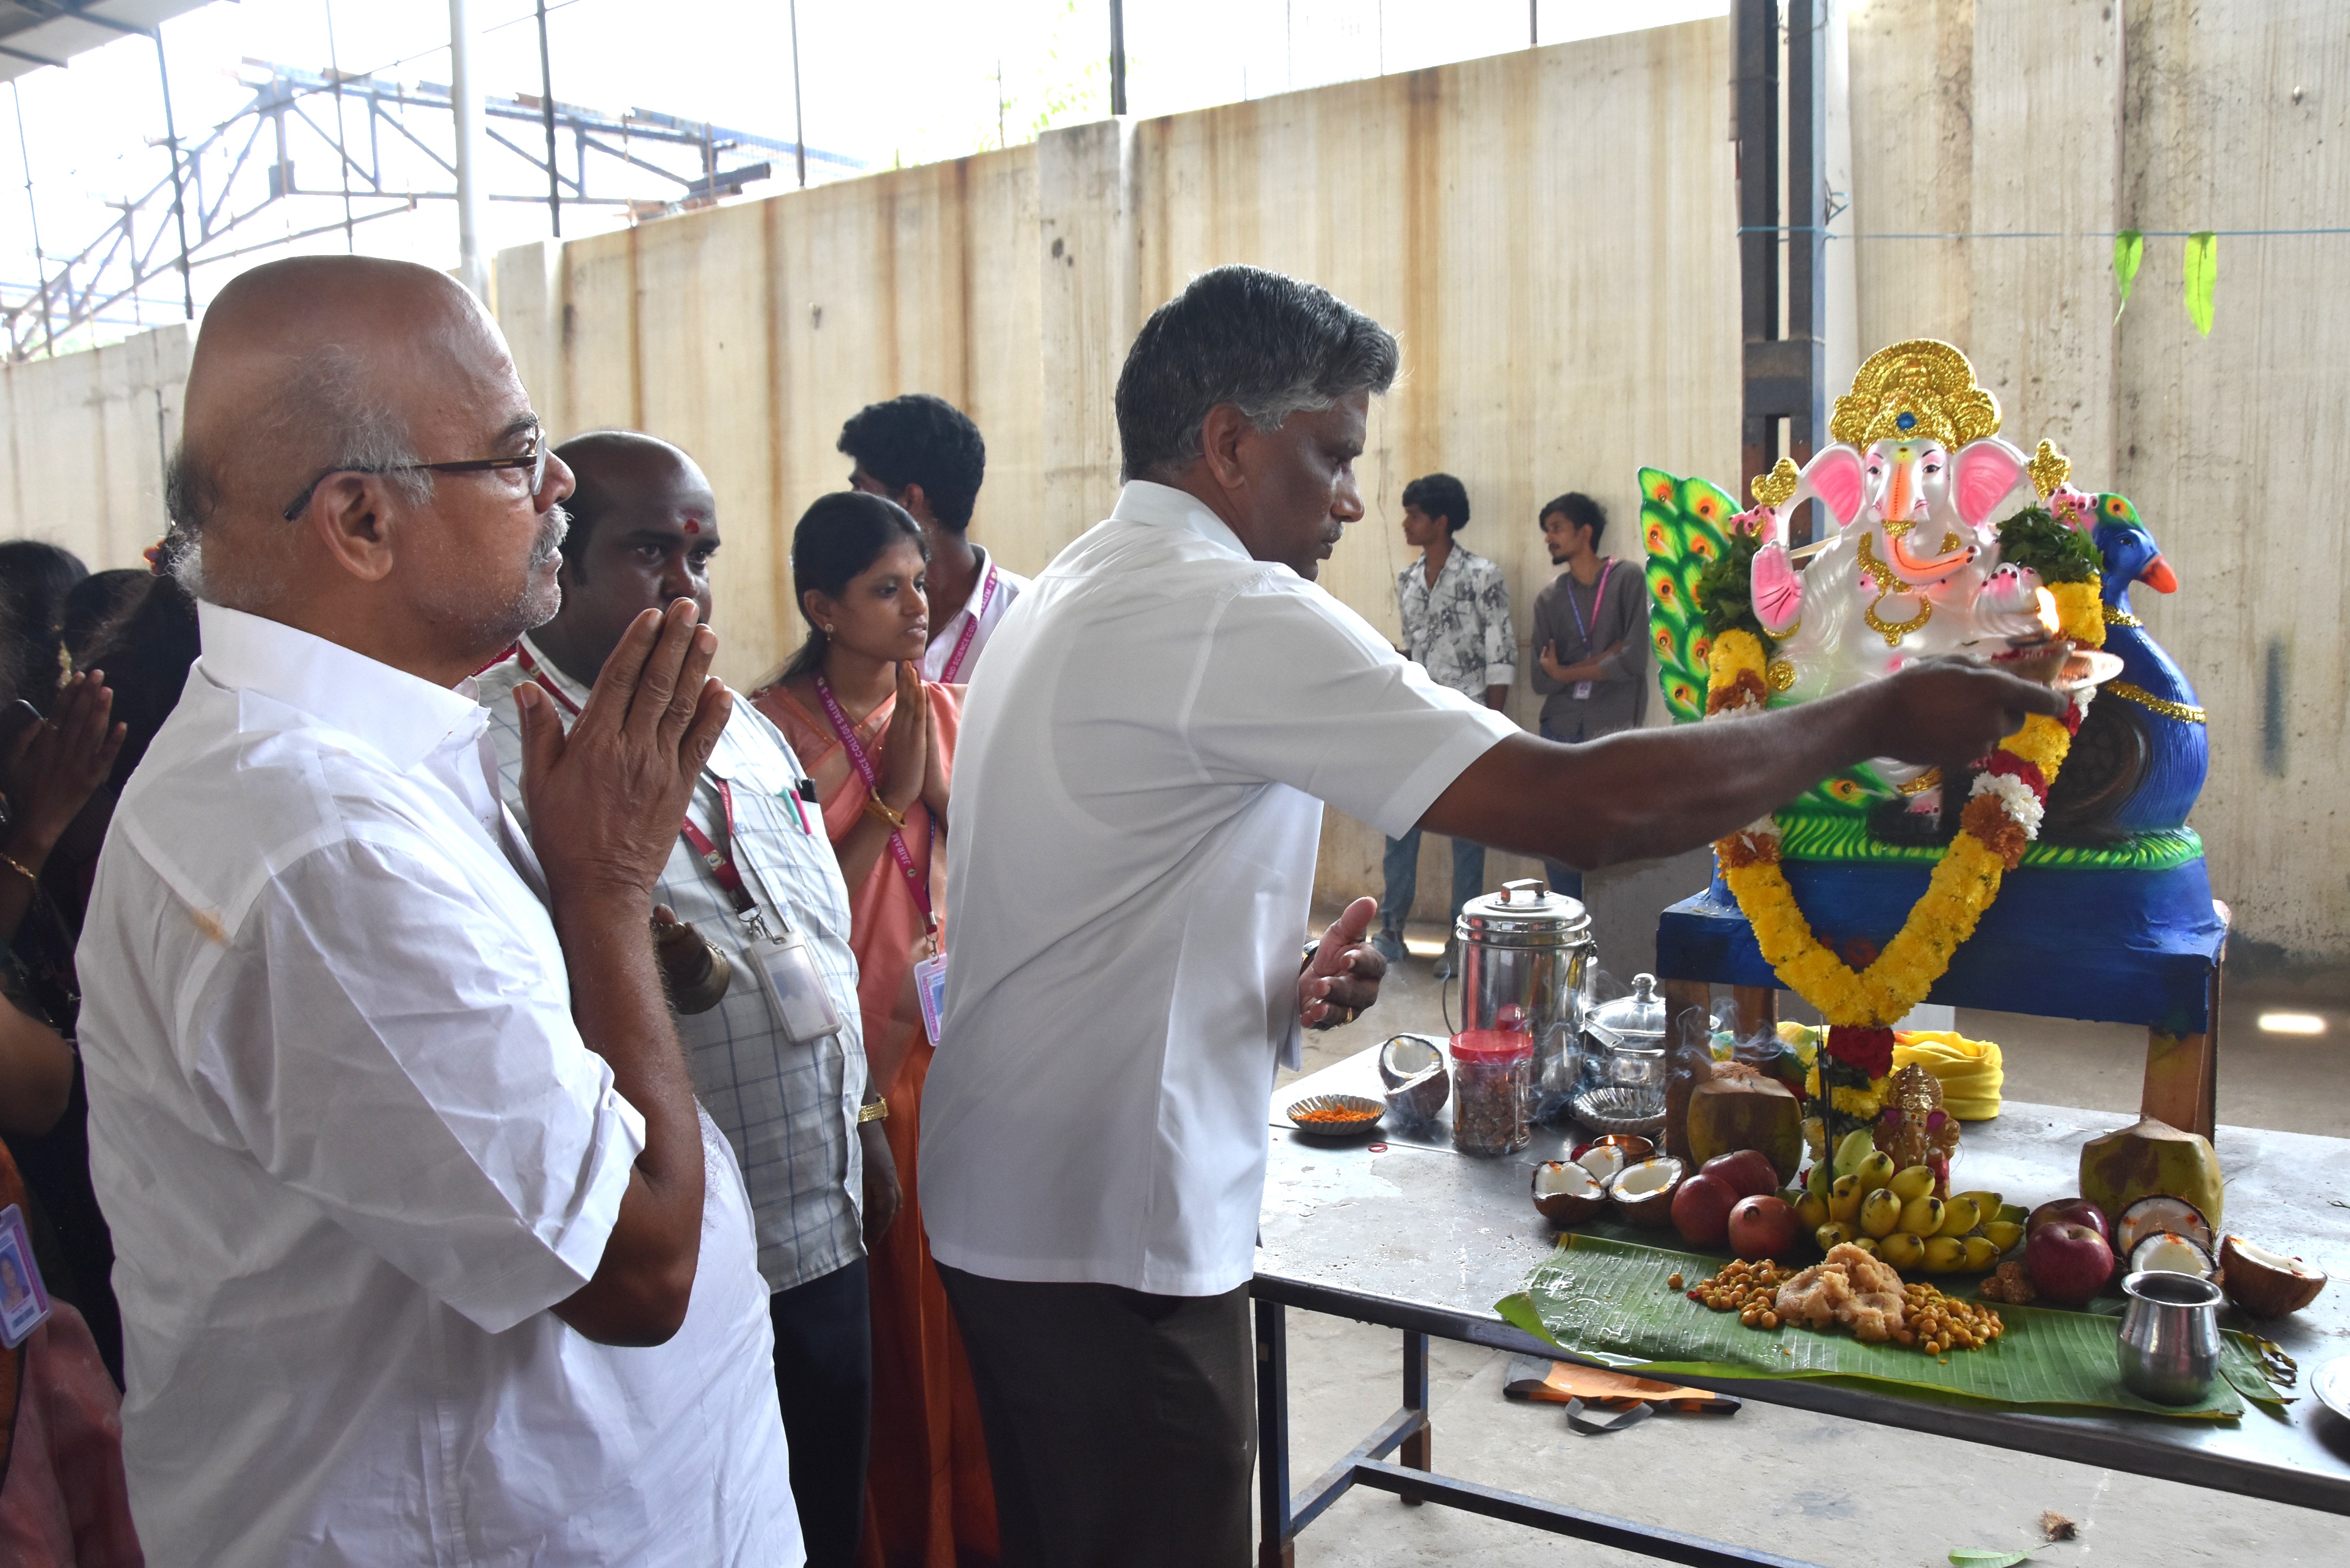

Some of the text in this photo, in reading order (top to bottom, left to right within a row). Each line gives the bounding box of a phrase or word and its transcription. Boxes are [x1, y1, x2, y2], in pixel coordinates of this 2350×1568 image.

[946, 666, 956, 681] AND
[953, 637, 970, 665] SCIENCE
[826, 698, 844, 724] SALEM
[839, 723, 862, 757] COLLEGE
[859, 757, 876, 787] CIENCE
[892, 833, 911, 864] JAIRAM
